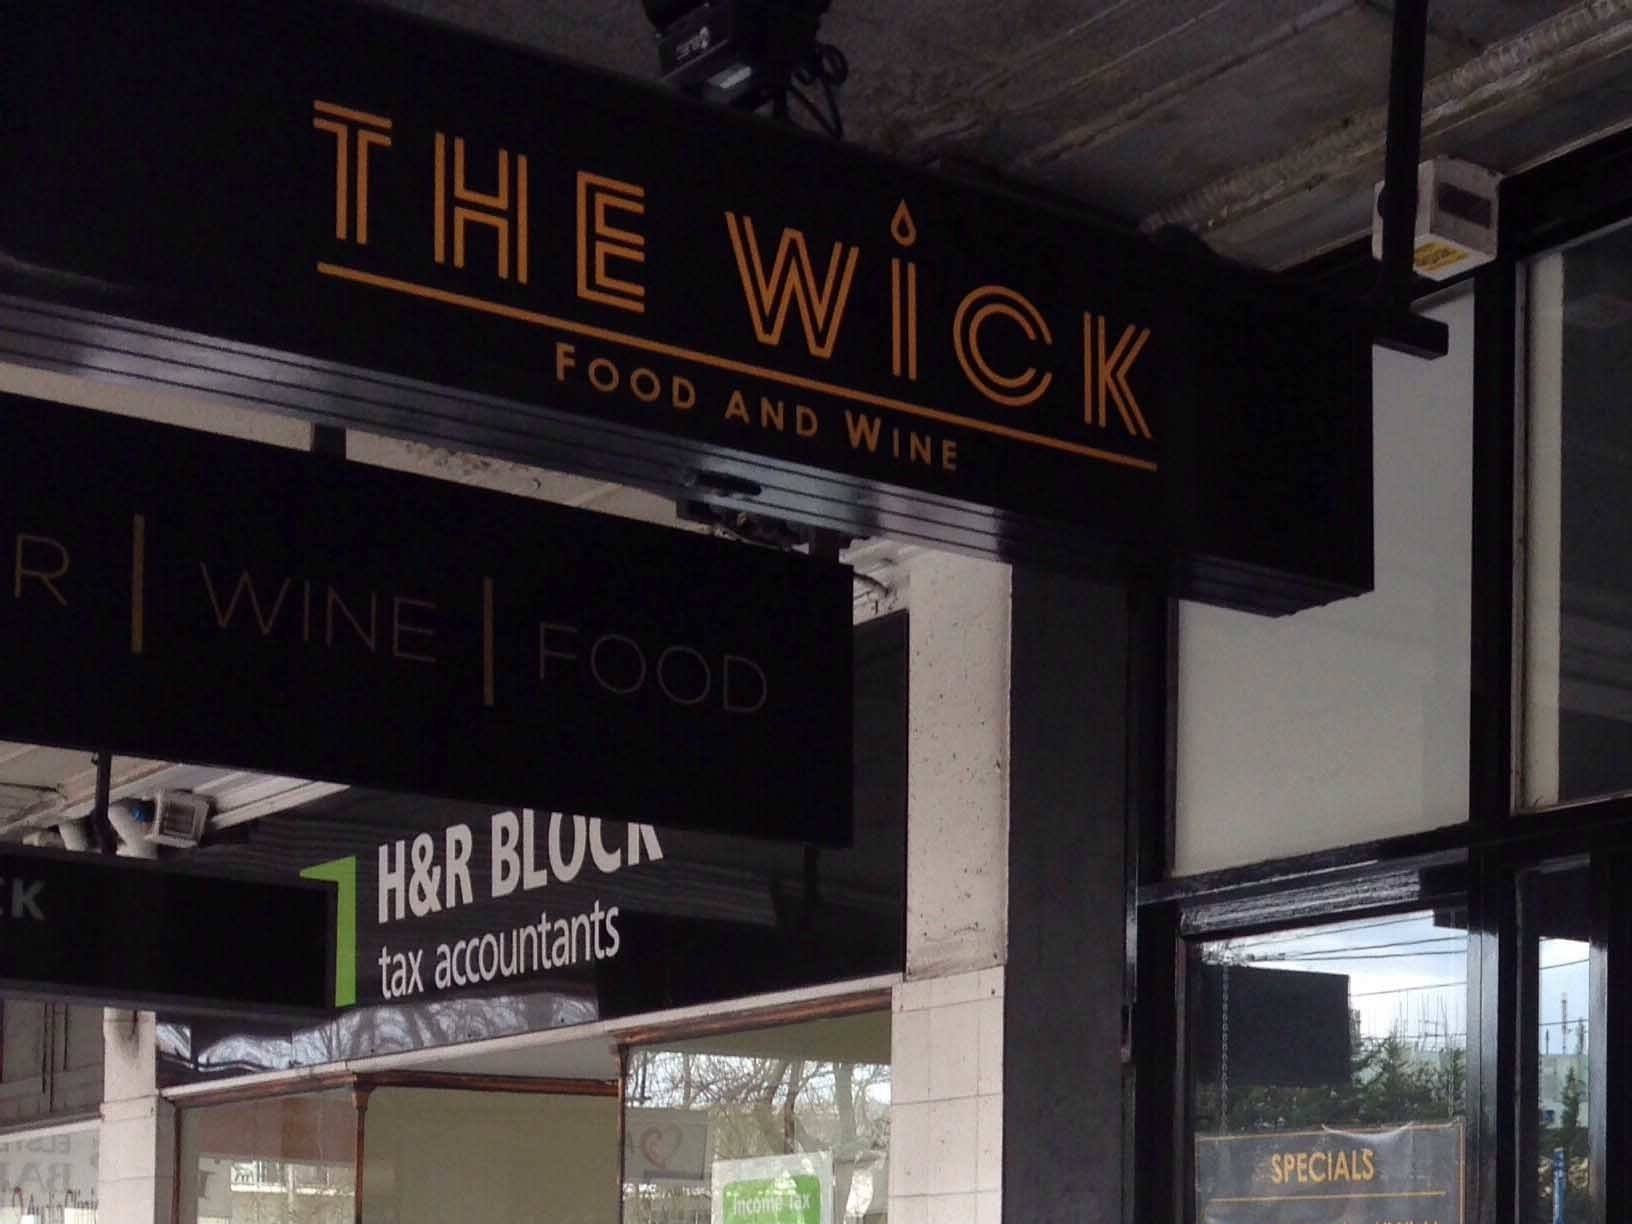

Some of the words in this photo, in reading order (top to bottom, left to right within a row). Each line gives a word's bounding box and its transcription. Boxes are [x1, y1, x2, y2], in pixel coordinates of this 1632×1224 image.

[314, 101, 645, 312] THE
[726, 389, 819, 439] AND
[201, 560, 438, 663] WINE
[538, 621, 768, 713] FOOD
[379, 822, 472, 923] H&R
[379, 943, 423, 1001] tax
[434, 900, 621, 985] accountants
[1272, 1149, 1375, 1184] SPECIALS
